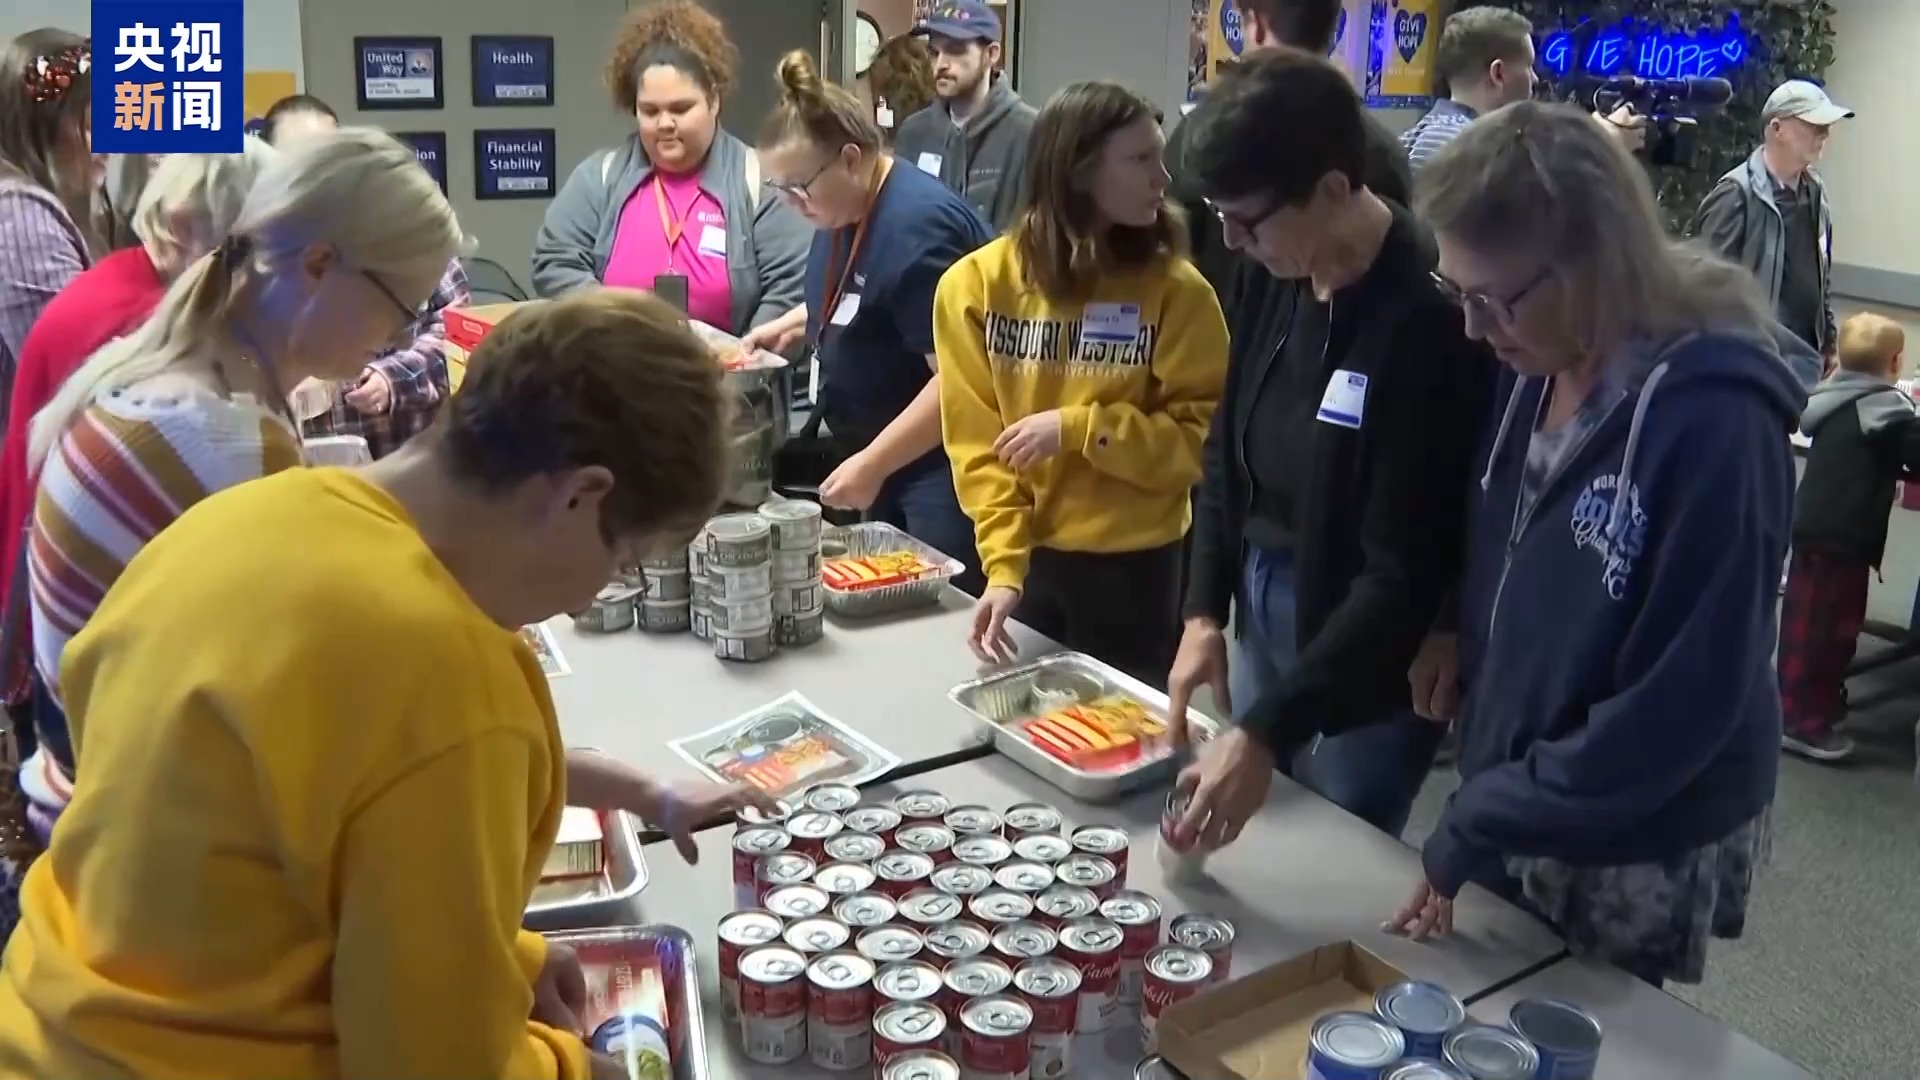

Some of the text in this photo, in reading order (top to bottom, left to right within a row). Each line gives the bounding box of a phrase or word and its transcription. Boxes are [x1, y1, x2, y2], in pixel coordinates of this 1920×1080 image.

[367, 52, 404, 64] United
[492, 51, 534, 64] Health
[1638, 36, 1720, 80] HOPE
[382, 64, 404, 77] Way
[487, 140, 543, 154] Financial
[489, 159, 541, 172] Stability
[985, 310, 1062, 361] ISSOURI
